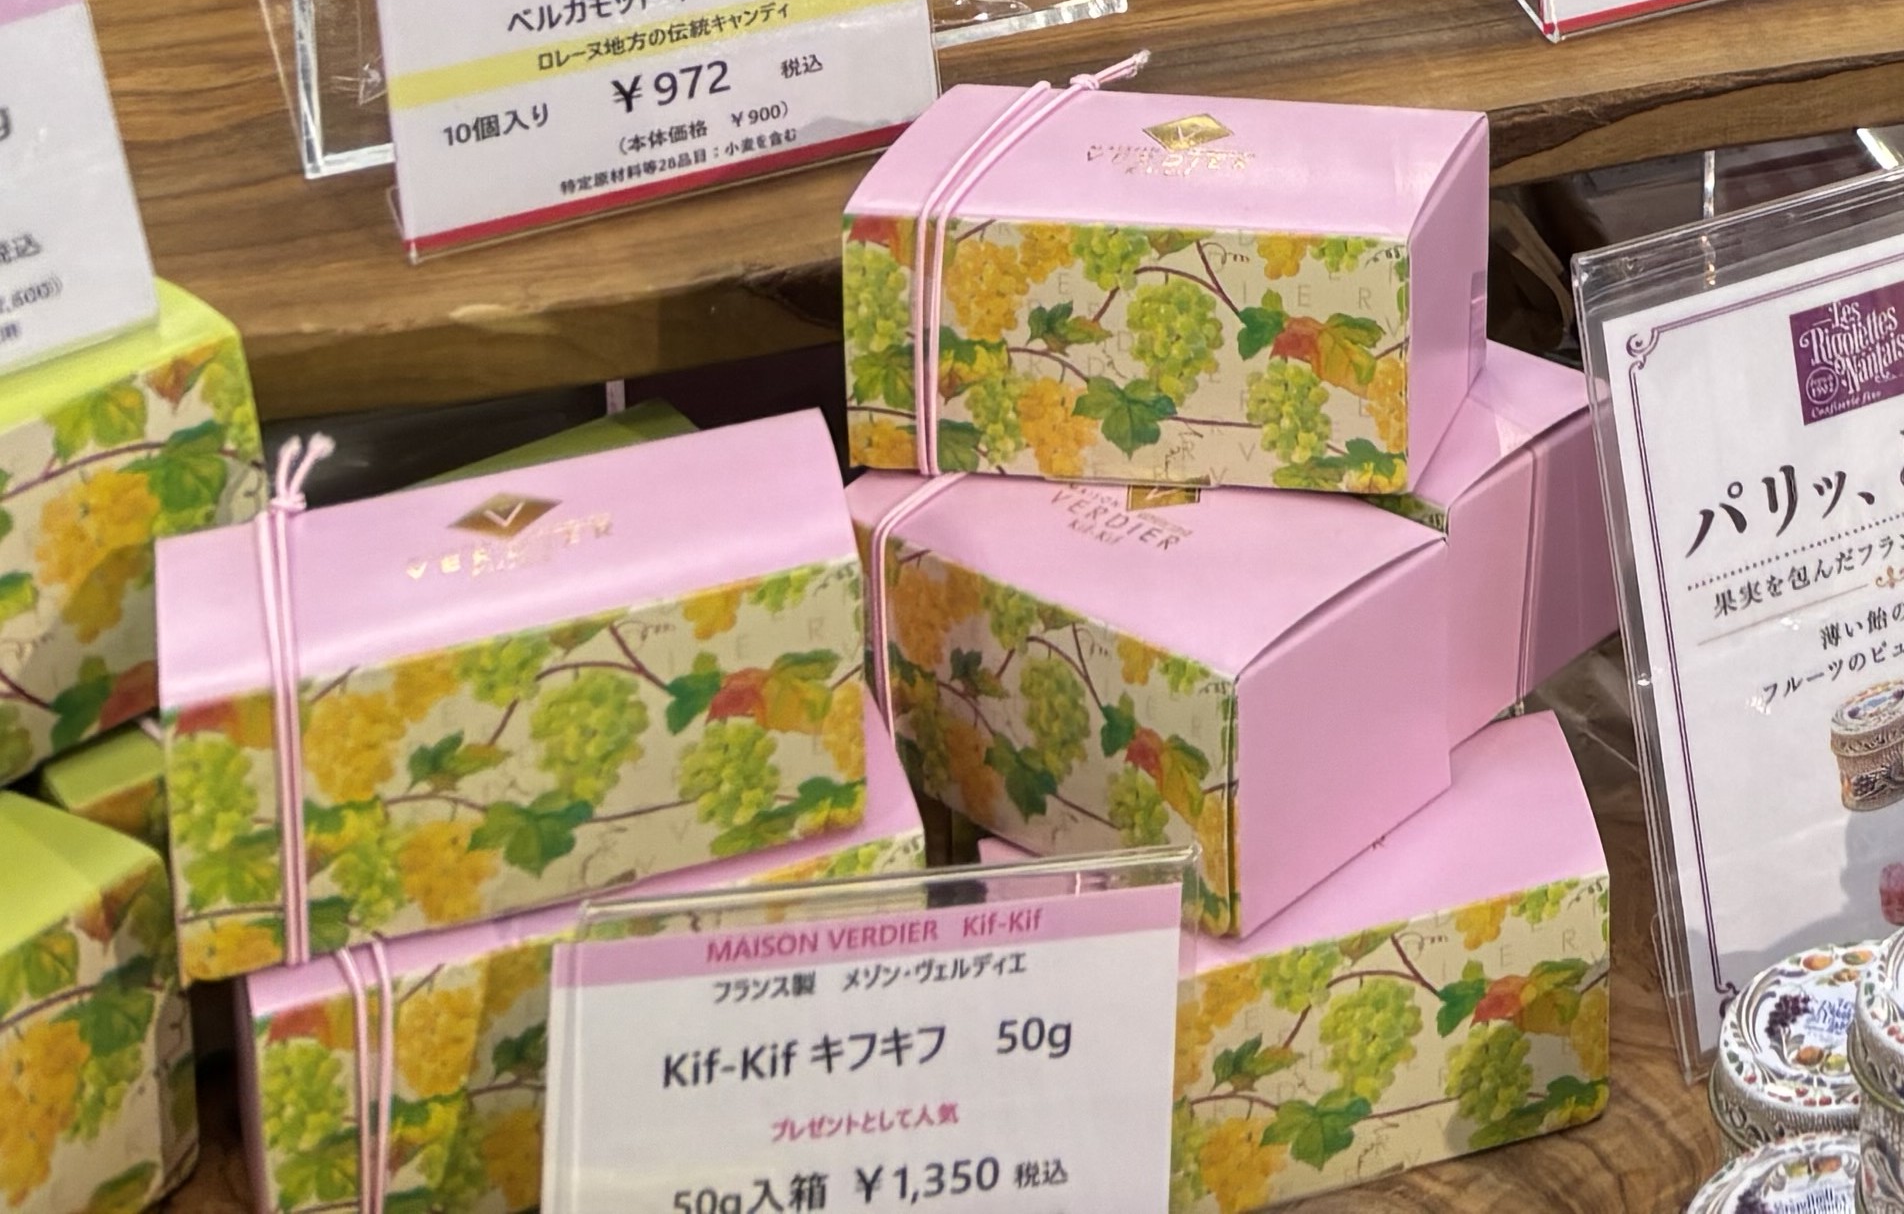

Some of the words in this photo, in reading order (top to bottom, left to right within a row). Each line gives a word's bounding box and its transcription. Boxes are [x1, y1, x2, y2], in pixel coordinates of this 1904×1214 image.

[537, 2, 789, 71] ロレーヌ地方の伝統キャンディ
[611, 61, 731, 112] ¥972
[781, 54, 823, 79] 税込
[443, 103, 550, 146] 10個入り
[1051, 489, 1181, 551] VERDIER
[707, 928, 819, 963] MAISON
[827, 919, 938, 952] VERDIER
[962, 909, 1042, 937] Kif-Kif
[715, 972, 816, 1003] フランス製
[842, 953, 1027, 991] メゾン・ヴェルディエ
[662, 1040, 797, 1089] Kif-Kif
[809, 1025, 948, 1069] キフキフ
[997, 1016, 1074, 1059] 50g
[771, 1104, 959, 1142] プレゼントとして人気
[855, 1156, 1001, 1205] ¥1,350
[1014, 1160, 1068, 1188] 税込
